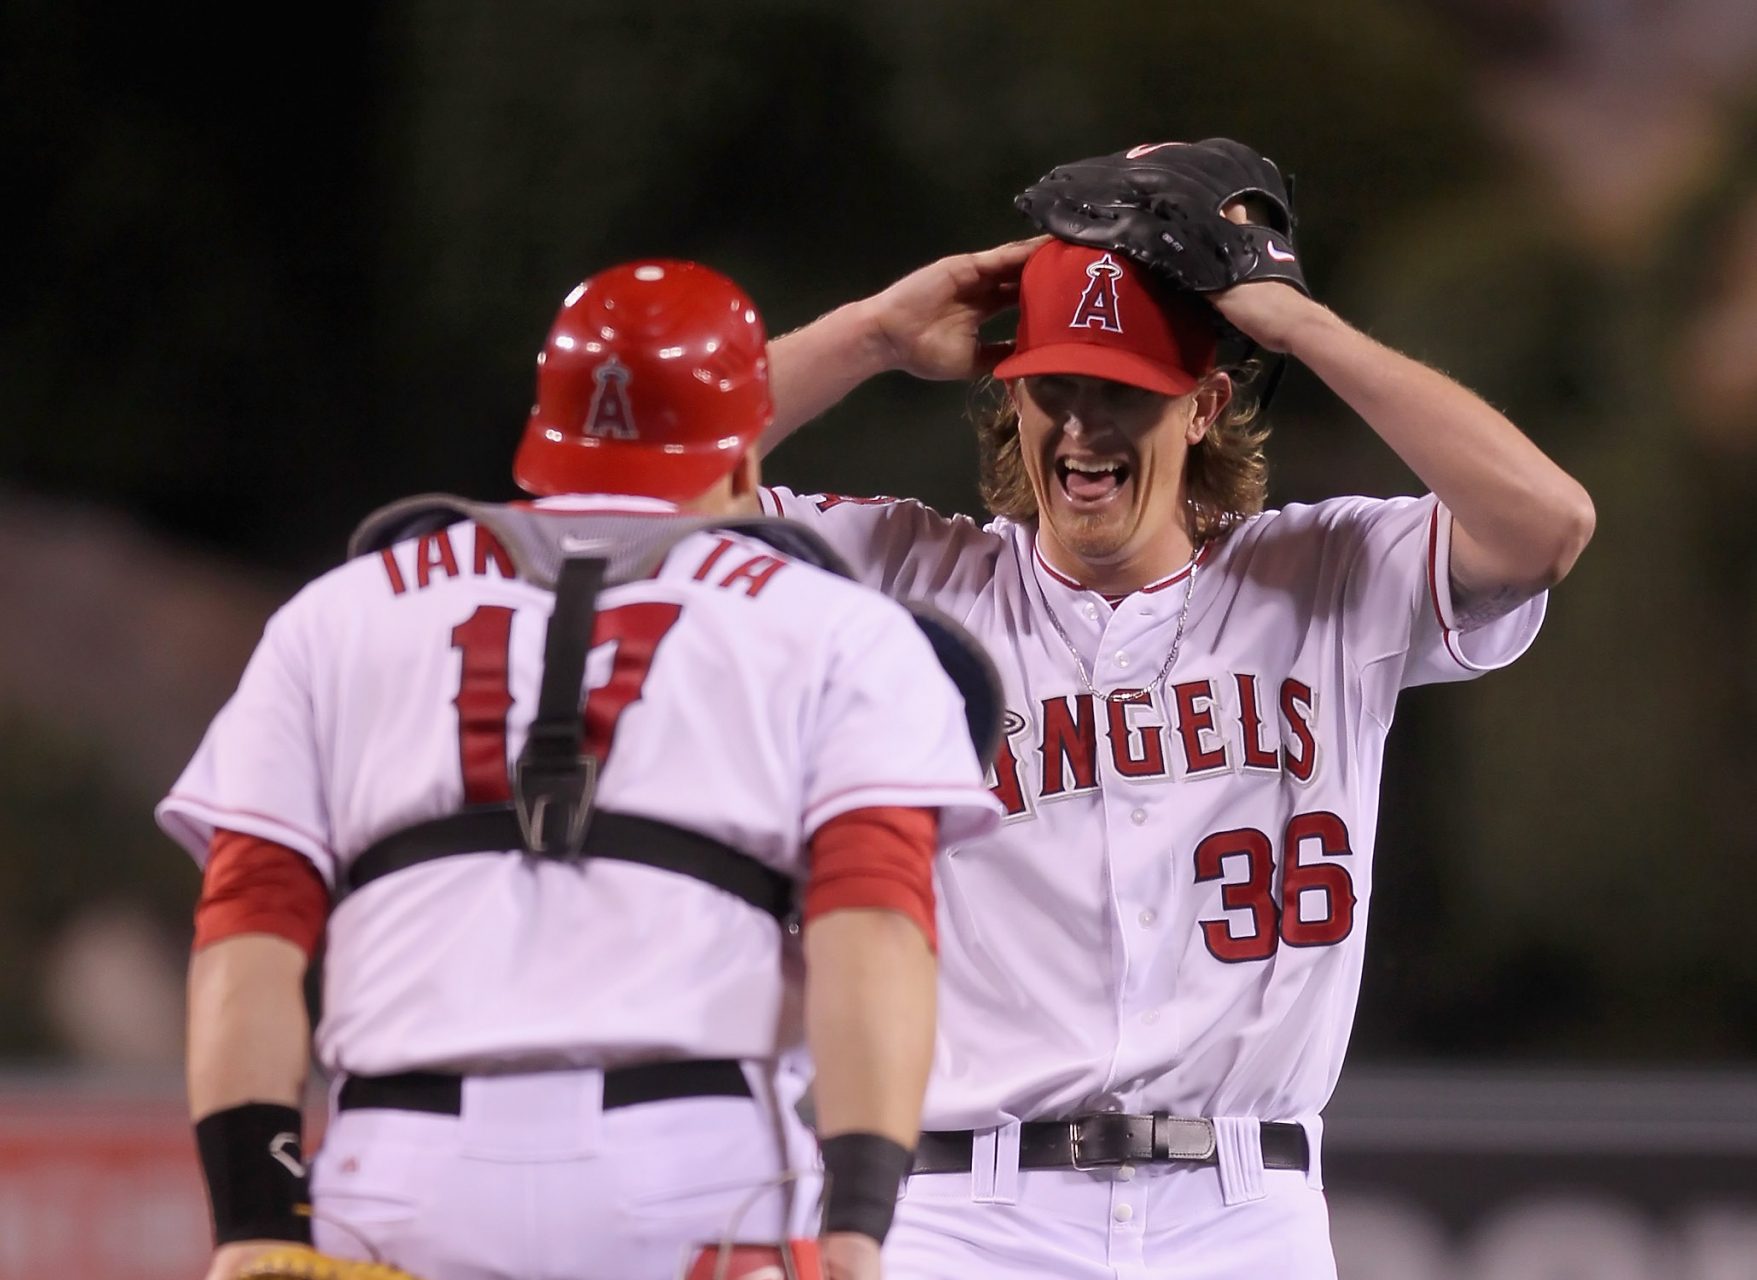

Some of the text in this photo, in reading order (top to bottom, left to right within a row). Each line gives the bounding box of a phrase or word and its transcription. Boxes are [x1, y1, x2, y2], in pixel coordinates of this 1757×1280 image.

[1069, 252, 1123, 333] A
[582, 352, 638, 439] A
[451, 602, 683, 804] 17
[1193, 810, 1358, 963] 36
